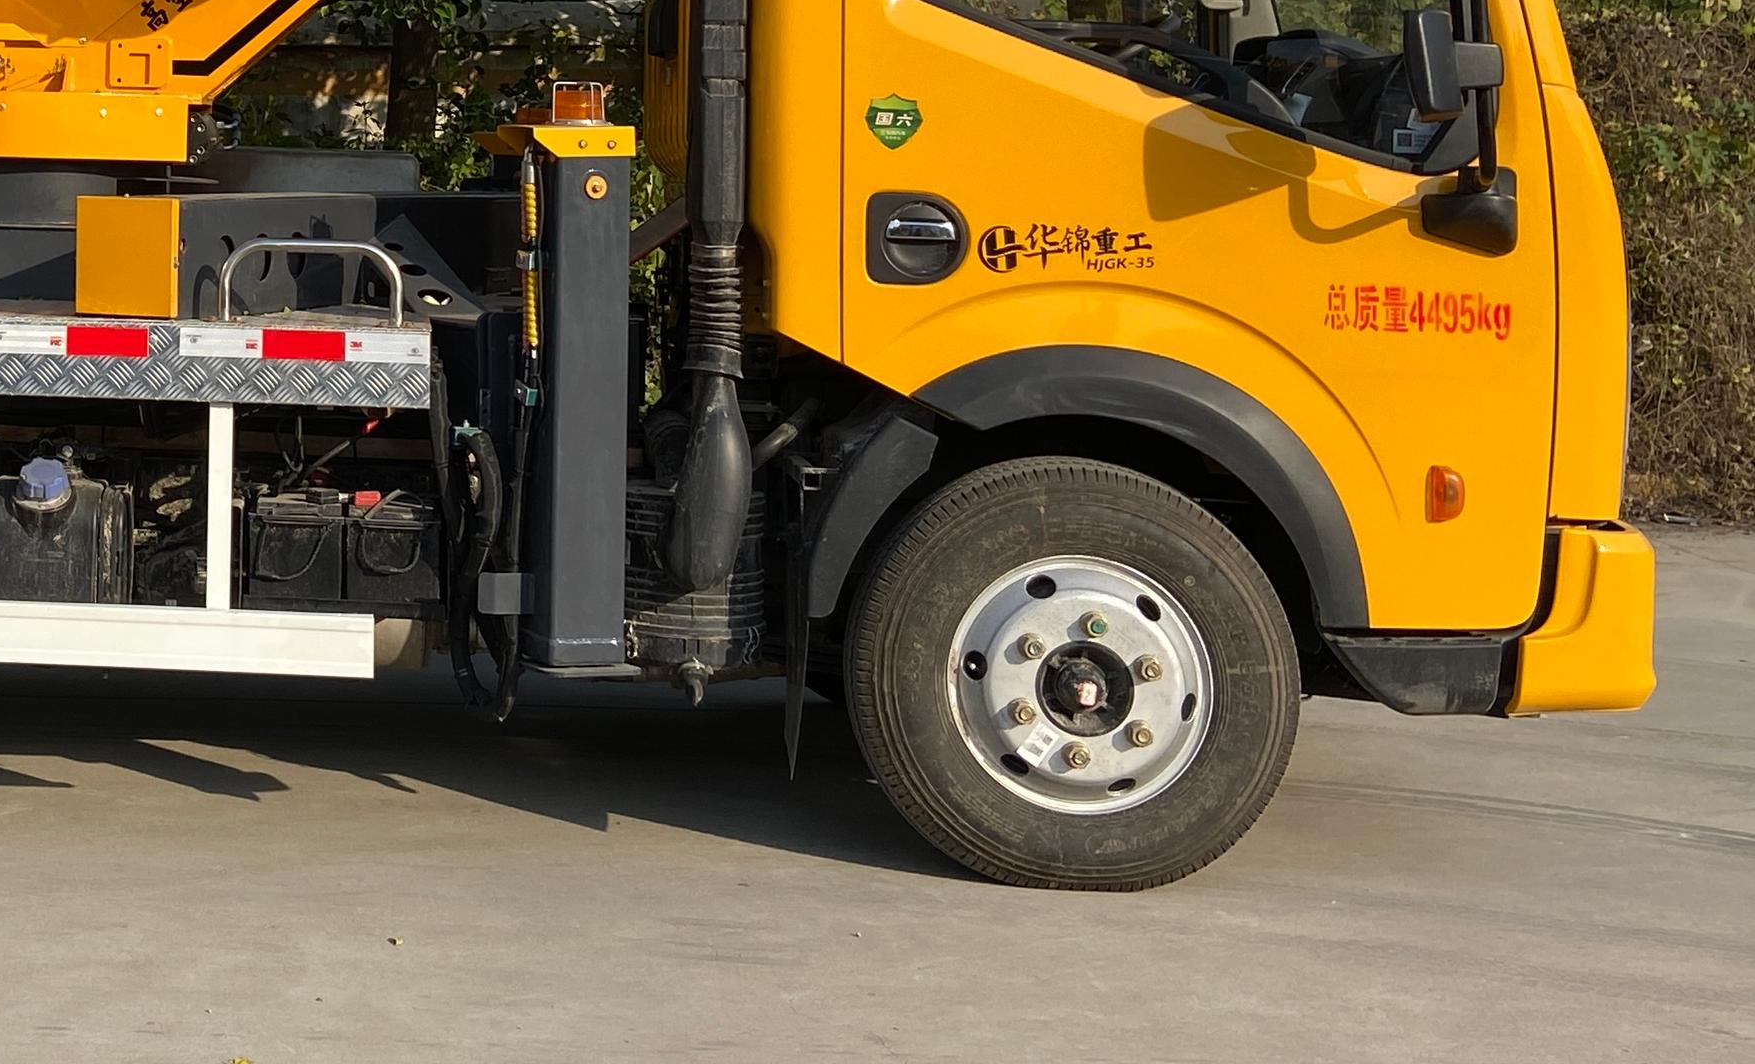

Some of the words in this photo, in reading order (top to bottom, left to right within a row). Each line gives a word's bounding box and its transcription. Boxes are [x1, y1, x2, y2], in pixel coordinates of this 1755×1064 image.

[875, 112, 914, 127] 国六
[1022, 223, 1153, 270] 华锦重工
[1086, 256, 1155, 272] HJGK-35
[1324, 284, 1512, 341] 总质量4495kg
